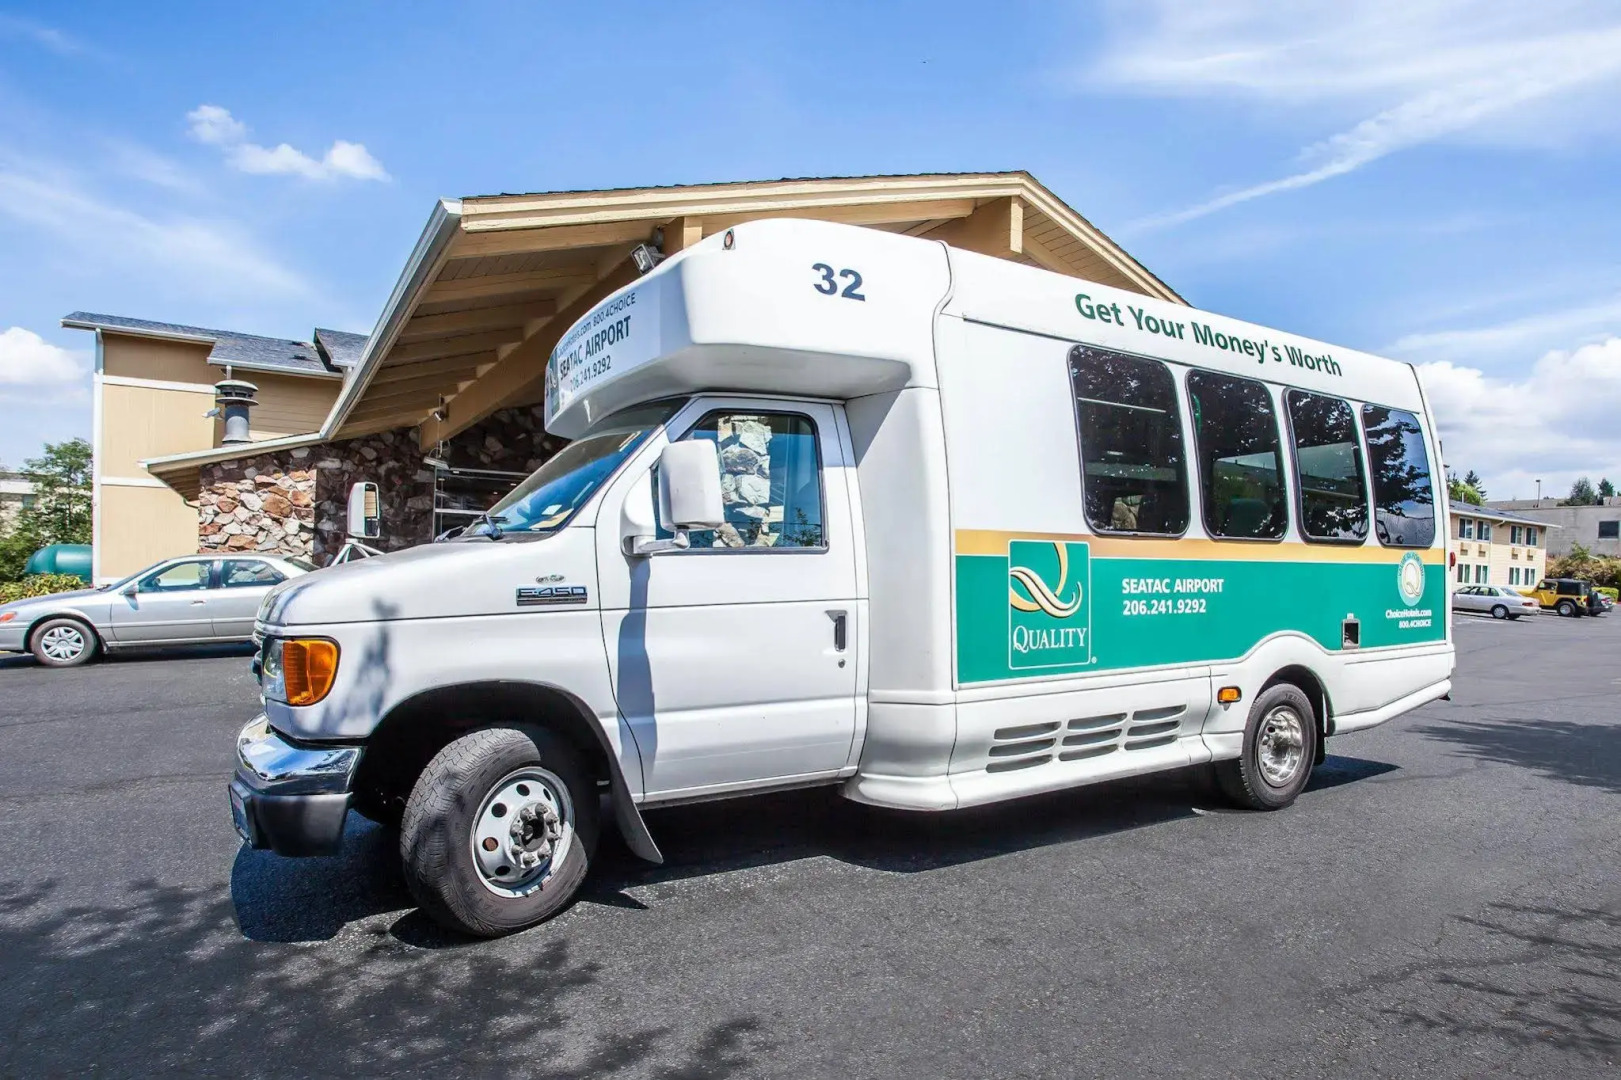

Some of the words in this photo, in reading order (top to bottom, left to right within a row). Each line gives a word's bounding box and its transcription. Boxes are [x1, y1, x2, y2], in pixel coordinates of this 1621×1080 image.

[812, 263, 865, 302] 32
[593, 292, 636, 327] 800.4CHOICE
[559, 345, 583, 380] SEATAC
[585, 315, 631, 360] AIRPORT
[1075, 293, 1124, 327] Get
[1128, 305, 1184, 340] Your
[1191, 321, 1282, 365] Money's
[1284, 344, 1342, 377] Worth
[1122, 578, 1170, 594] SEATAC
[1174, 578, 1224, 593] AIRPORT
[1123, 598, 1206, 616] 206.241.9292
[1013, 625, 1088, 653] QUALITY
